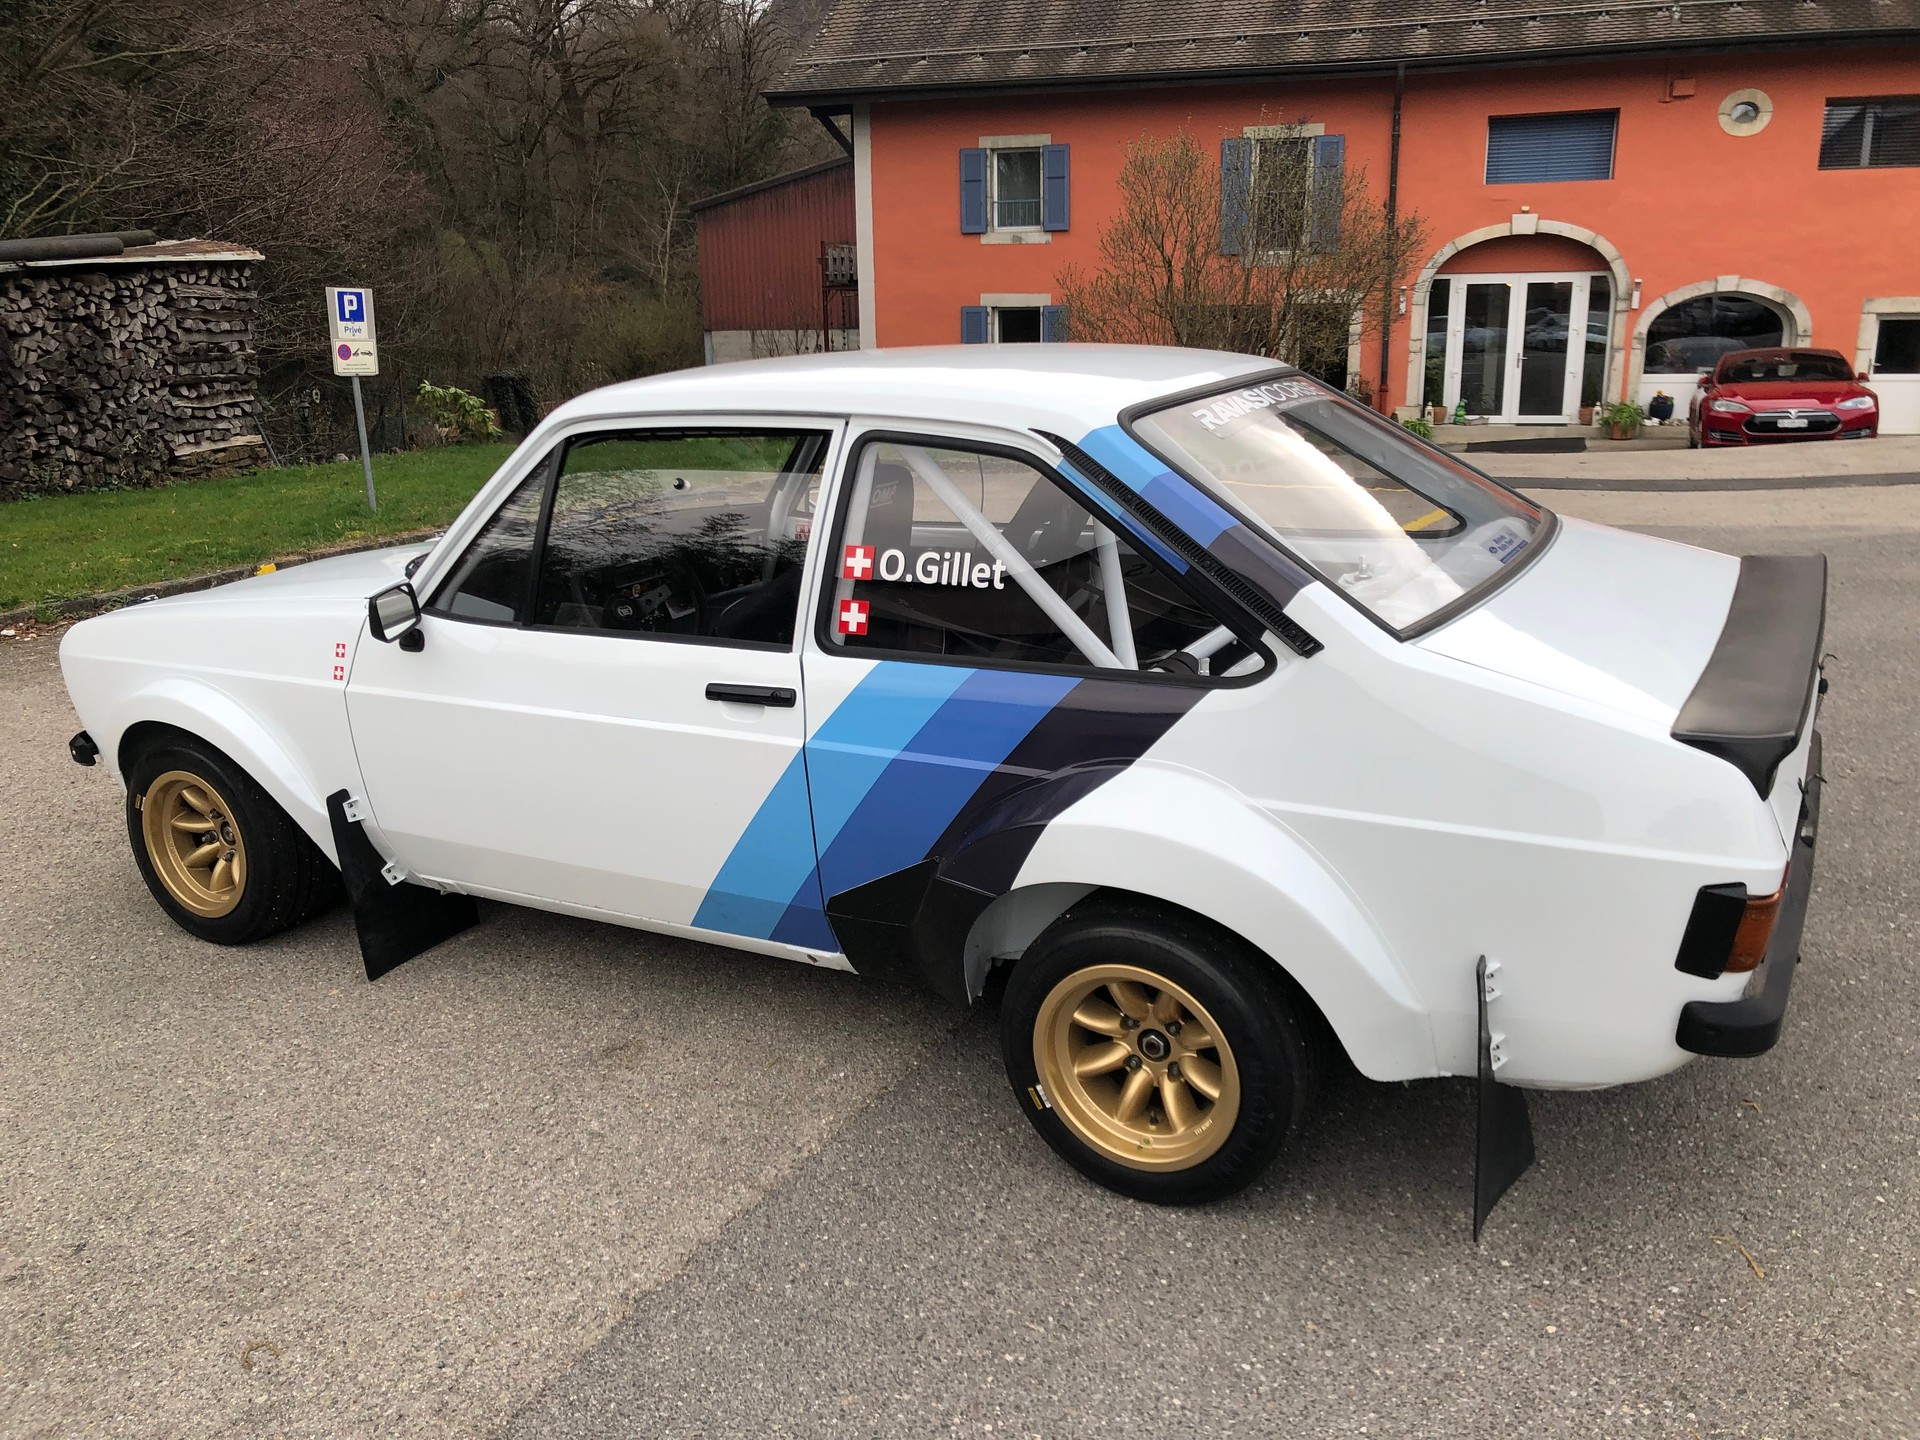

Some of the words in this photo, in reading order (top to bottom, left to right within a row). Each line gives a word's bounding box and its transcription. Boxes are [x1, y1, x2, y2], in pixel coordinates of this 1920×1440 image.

[344, 295, 357, 319] P
[344, 325, 362, 334] Privé
[872, 485, 897, 504] OMP
[879, 548, 1007, 591] O.Gillet
